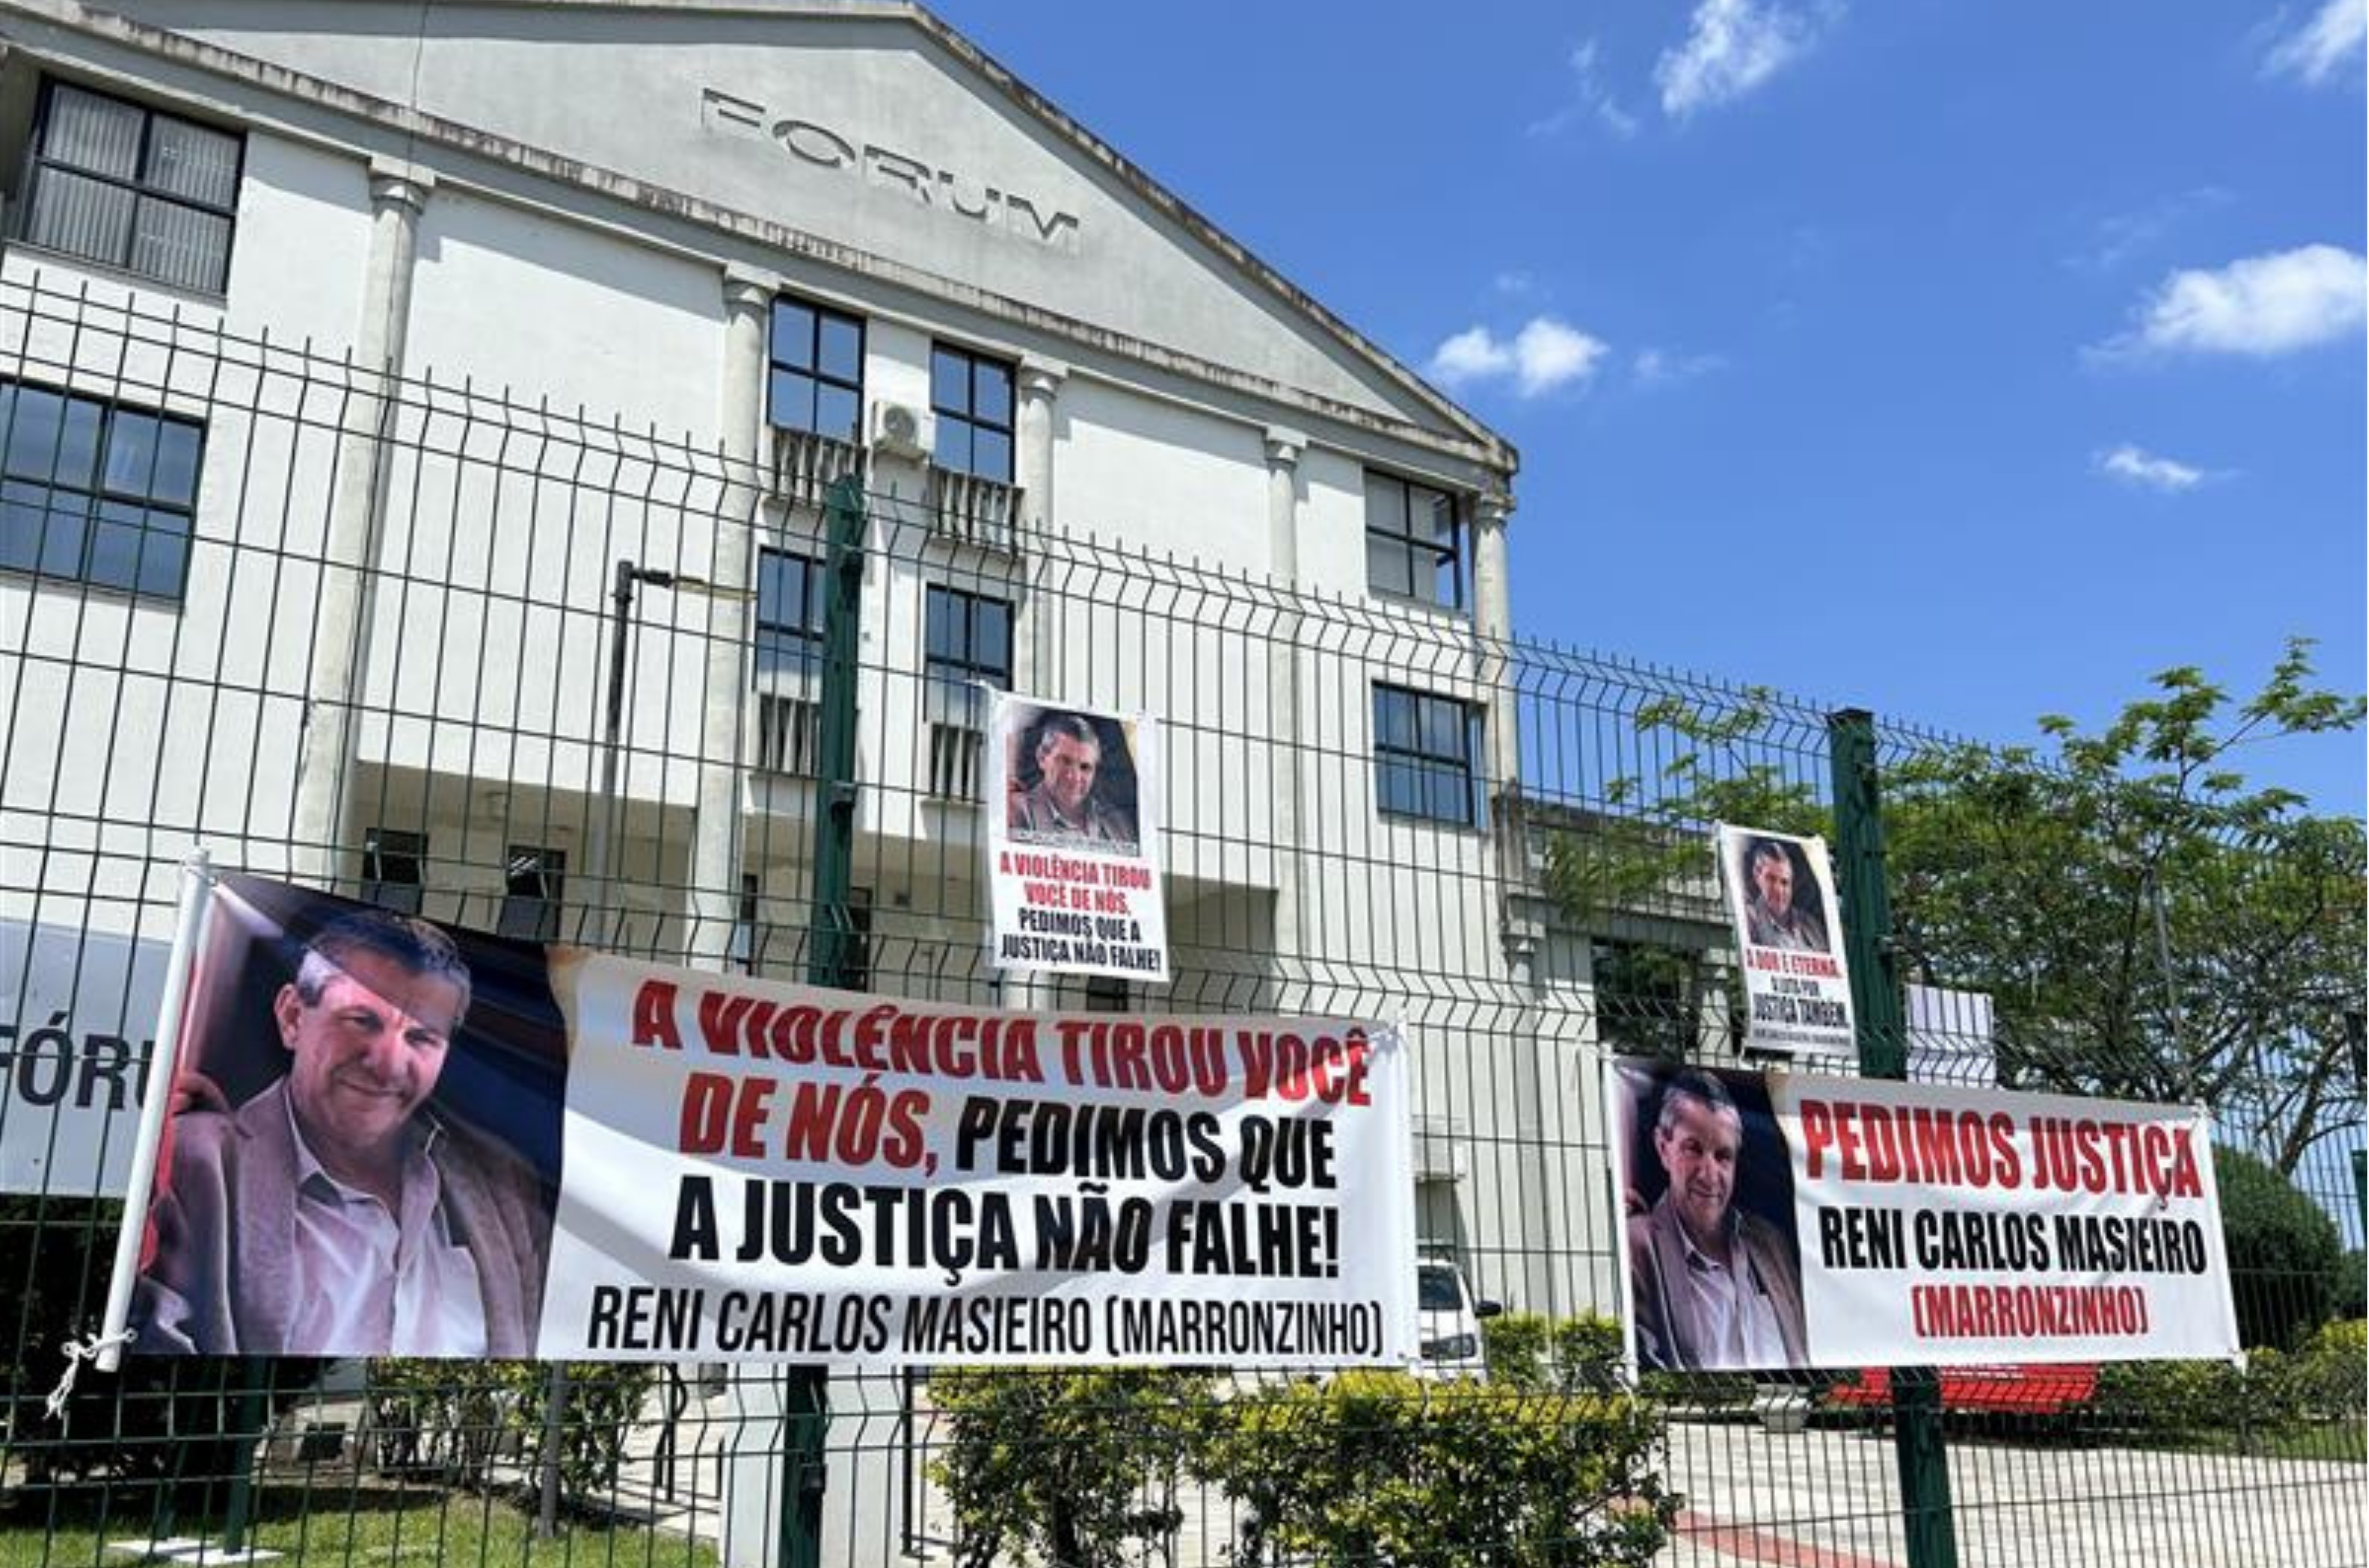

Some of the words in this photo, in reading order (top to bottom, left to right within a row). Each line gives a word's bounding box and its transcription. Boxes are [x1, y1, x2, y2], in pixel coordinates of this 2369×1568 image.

[701, 87, 1079, 251] FORUM
[1000, 851, 1011, 875] A
[1014, 852, 1099, 884] VIOLÊNCIA
[1102, 862, 1150, 890] TIROU
[1024, 880, 1067, 907] VOCÊ
[1071, 886, 1090, 910] DE
[1000, 934, 1071, 966] JUSTIÇA
[1074, 937, 1107, 965] NÃO
[1109, 945, 1161, 972] FALHE!
[1018, 907, 1093, 937] PEDIMOS
[1095, 916, 1127, 942] QUE
[1130, 920, 1141, 943] A
[631, 979, 683, 1050] A
[698, 991, 1045, 1084] VIOLÊNCIA
[1054, 1019, 1228, 1098] TIROU
[1236, 1026, 1372, 1106] VOCÊ
[679, 1071, 775, 1159] DE
[786, 1072, 938, 1178] NÓS,
[956, 1094, 1226, 1184] PEDIMOS
[1238, 1114, 1337, 1194] QUE
[1799, 1099, 2021, 1189] PEDIMOS
[2031, 1115, 2203, 1211] JUSTIÇA
[669, 1174, 720, 1261] A
[736, 1178, 1020, 1286] JUSTIÇA
[1034, 1181, 1152, 1274] NÃO
[1166, 1199, 1339, 1278] FALHE!
[1818, 1205, 1907, 1269] RENI
[1915, 1208, 2049, 1273] CARLOS
[2052, 1211, 2207, 1275] MASIEIRO
[588, 1284, 704, 1351] RENI
[717, 1289, 893, 1354] CARLOS
[902, 1295, 1091, 1354] MASIEIRO
[1106, 1294, 1382, 1357] (MARRONZINHO)
[1911, 1284, 2148, 1339] (MARRONZINHO)
